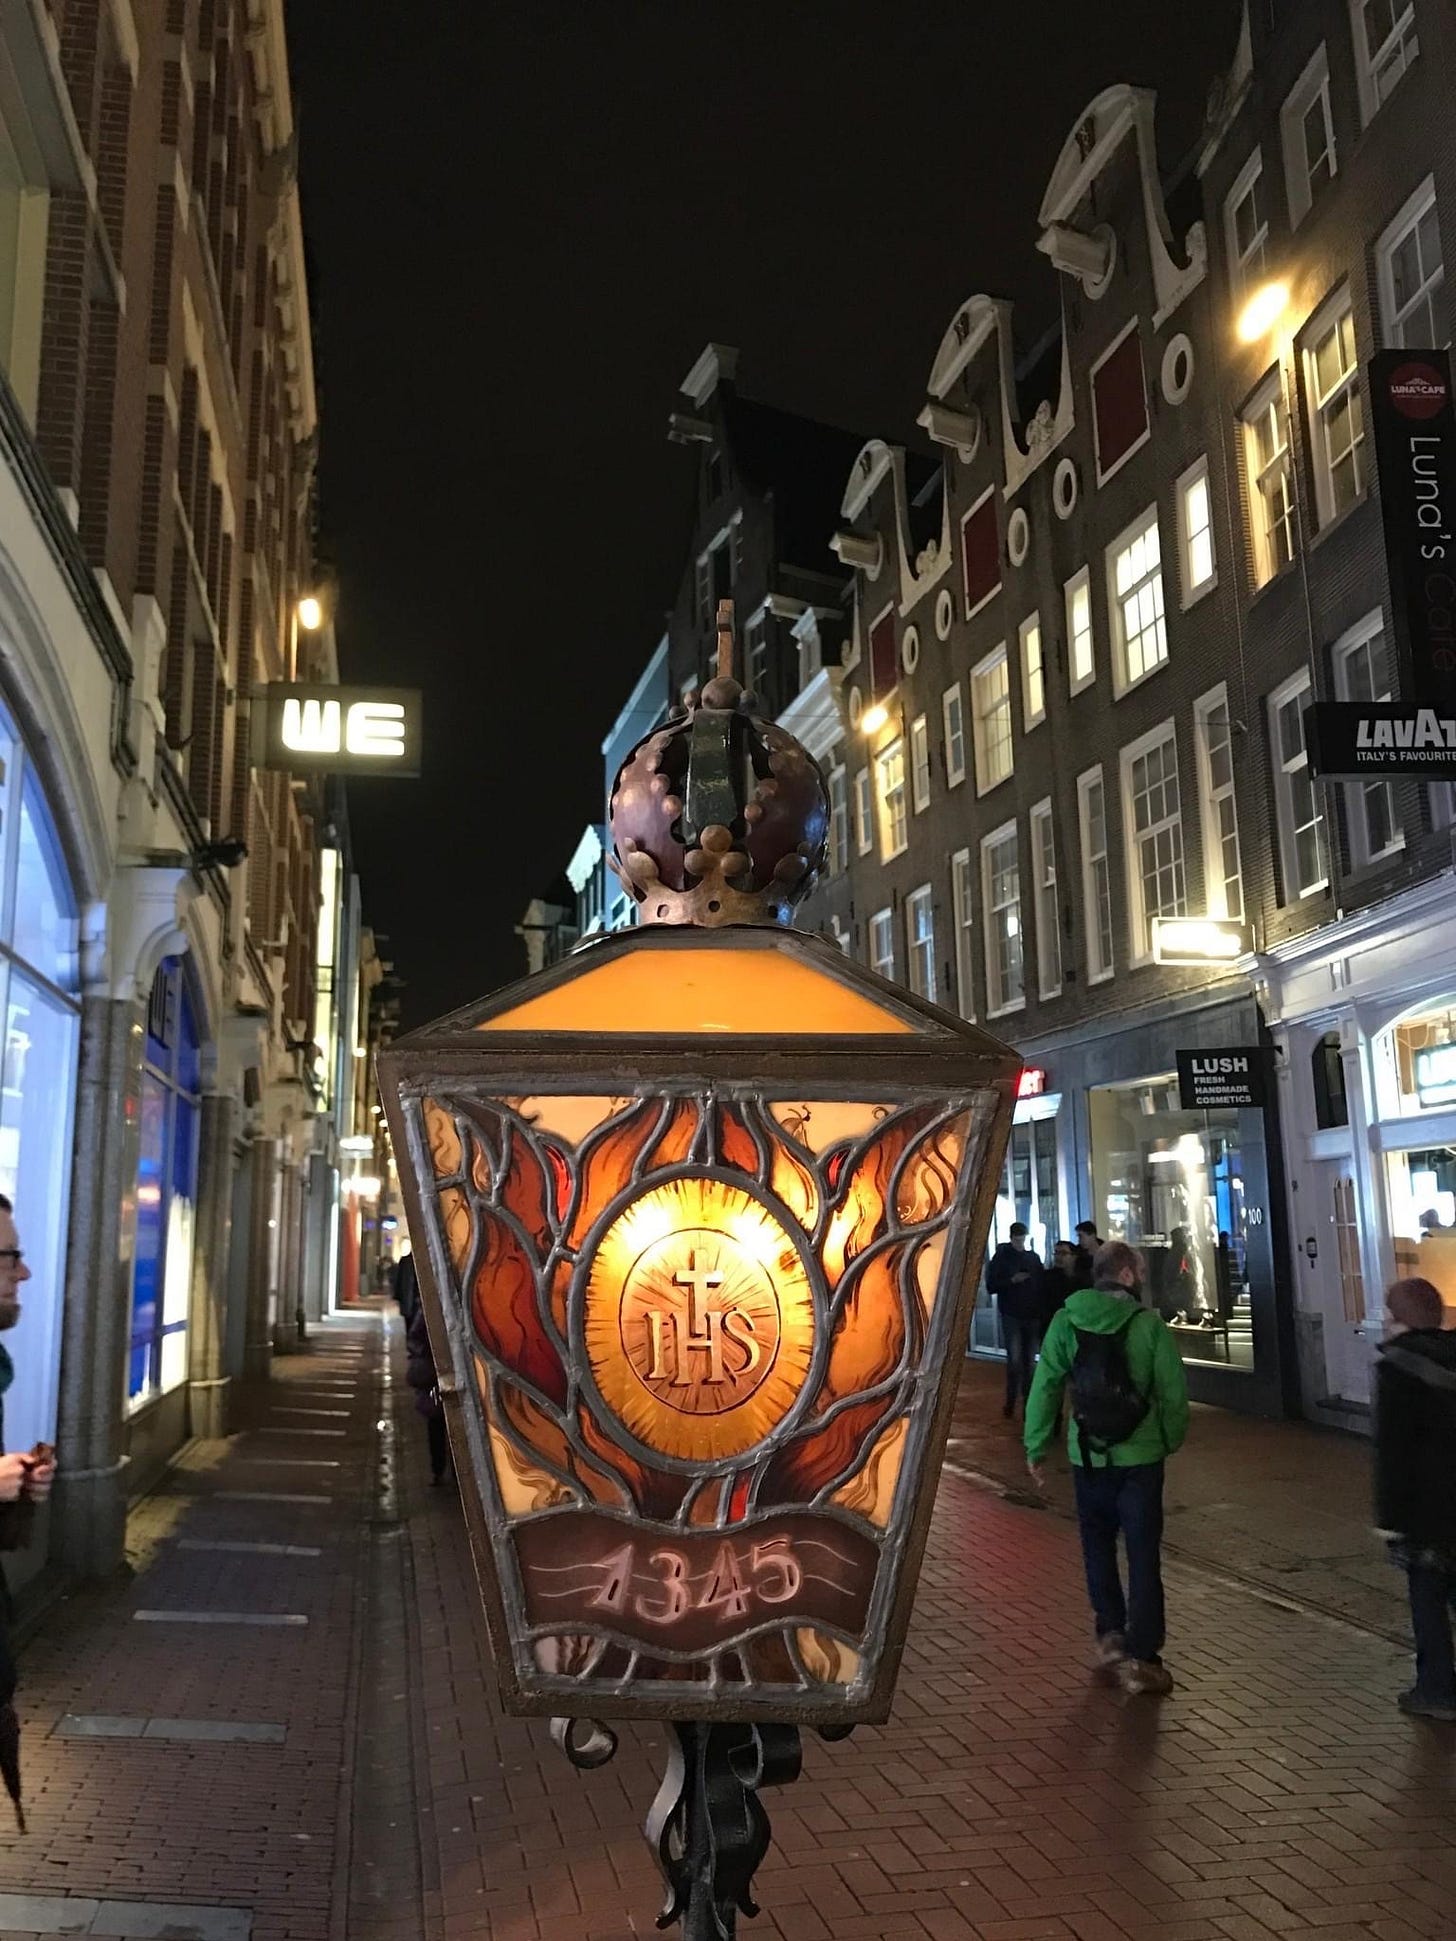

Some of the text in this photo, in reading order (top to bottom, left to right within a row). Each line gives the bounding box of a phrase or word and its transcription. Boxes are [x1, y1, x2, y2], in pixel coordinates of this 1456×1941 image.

[1410, 437, 1451, 559] Luna's
[281, 698, 405, 756] WE
[1357, 751, 1397, 761] ITALY'S
[1191, 1057, 1249, 1074] LUSH
[1193, 1076, 1226, 1084] FRESH
[1195, 1085, 1250, 1094] HANDMADE
[1196, 1095, 1252, 1104] COSMETICS
[643, 1307, 761, 1387] IHS
[588, 1538, 800, 1624] 1345
